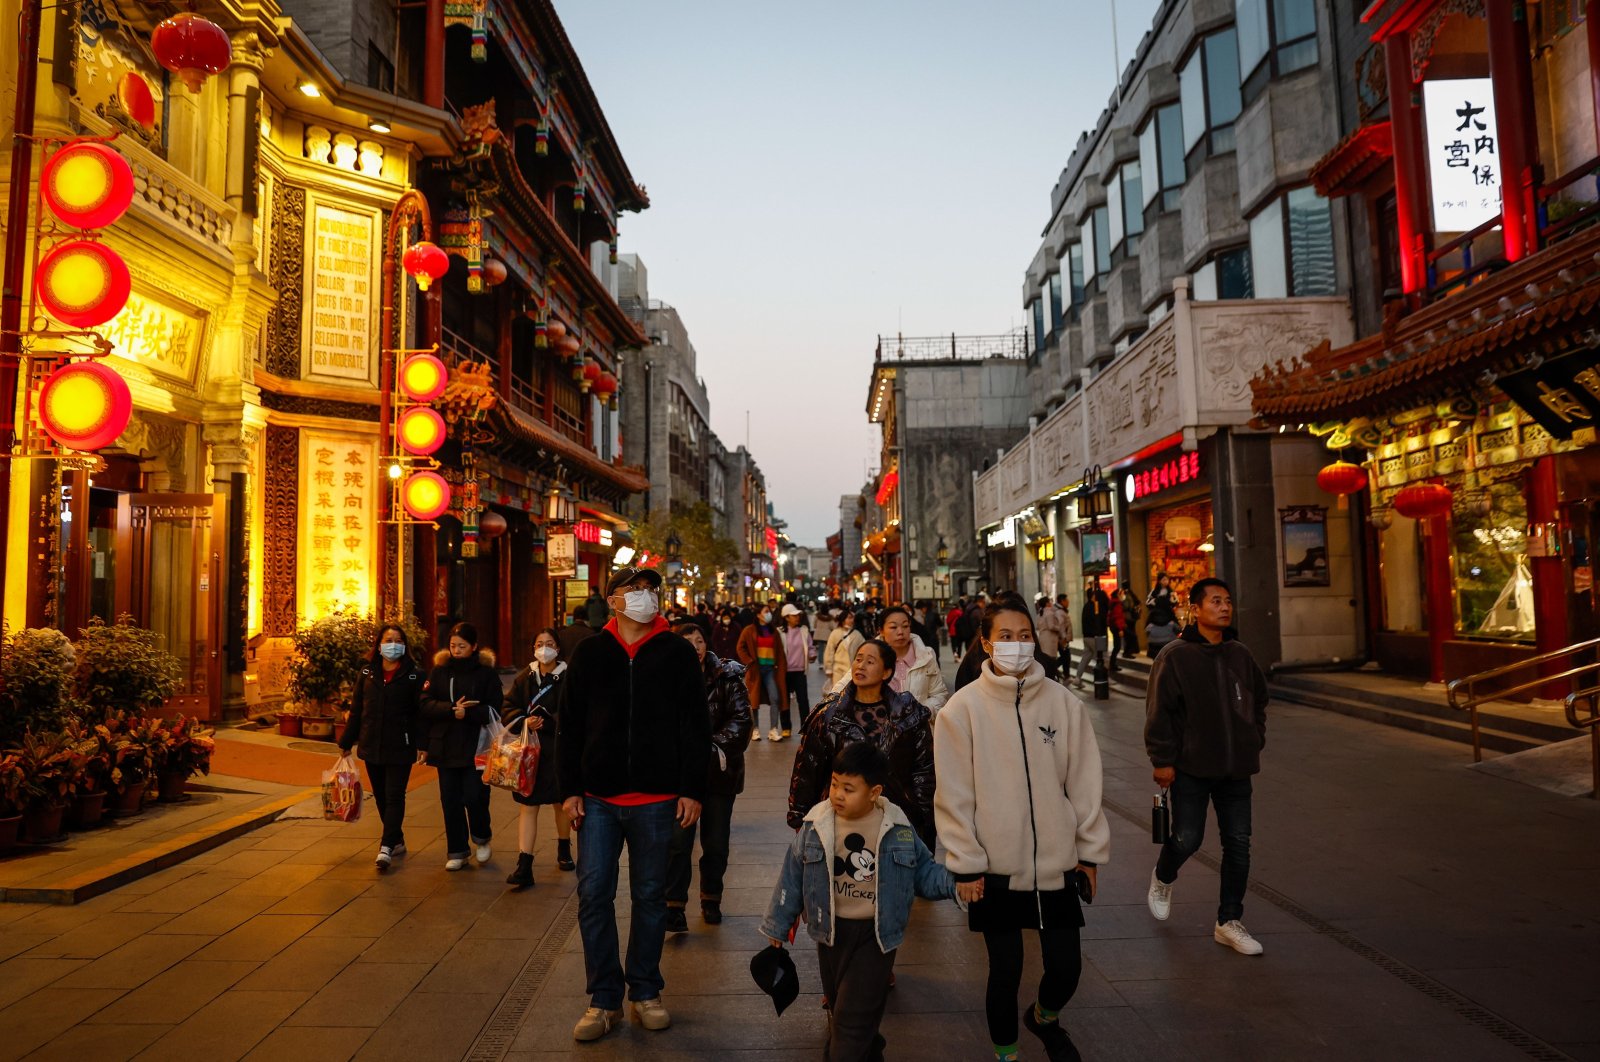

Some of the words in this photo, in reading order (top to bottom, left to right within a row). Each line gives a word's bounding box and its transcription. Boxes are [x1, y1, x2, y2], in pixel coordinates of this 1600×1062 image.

[339, 296, 353, 312] FOR
[350, 317, 366, 333] NICE
[314, 330, 349, 348] SELECTION
